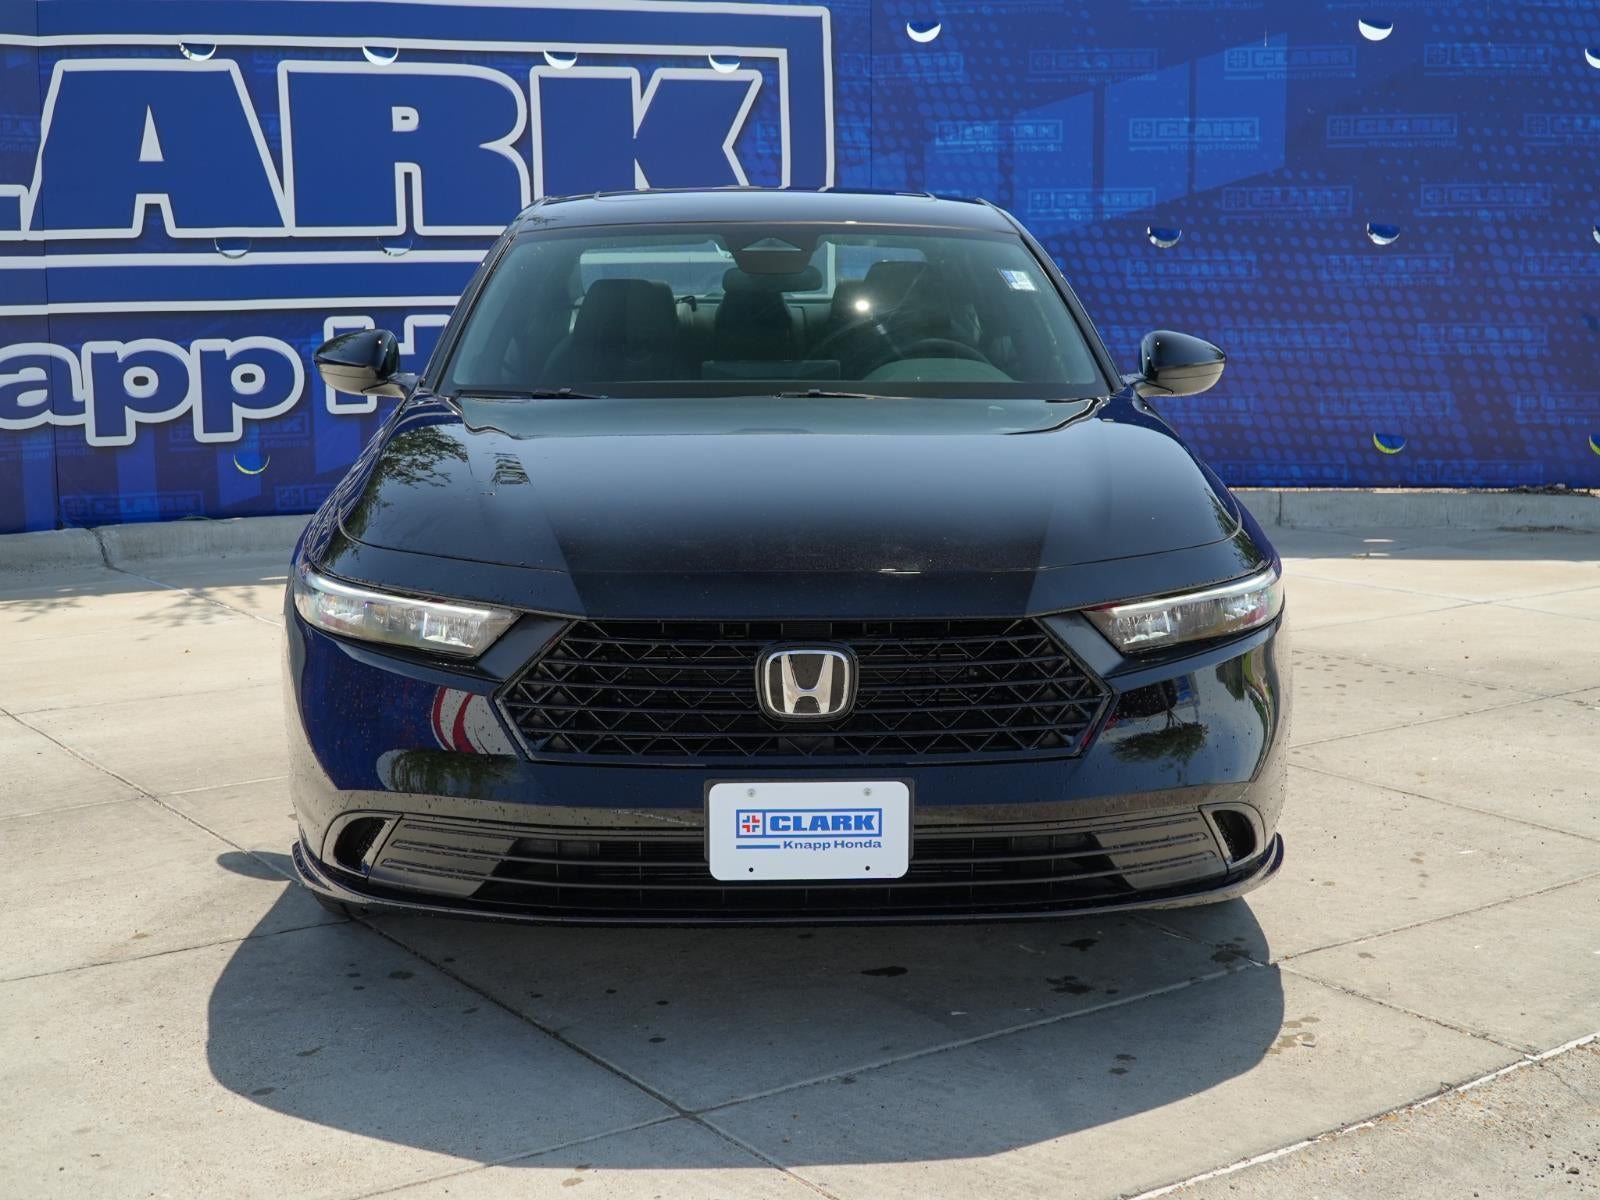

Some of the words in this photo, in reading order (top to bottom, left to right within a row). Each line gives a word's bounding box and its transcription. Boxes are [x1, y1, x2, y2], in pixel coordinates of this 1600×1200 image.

[1158, 121, 1254, 137] CLARK
[769, 815, 875, 831] CLARK
[783, 840, 831, 851] Knapp
[833, 839, 882, 849] Honda
